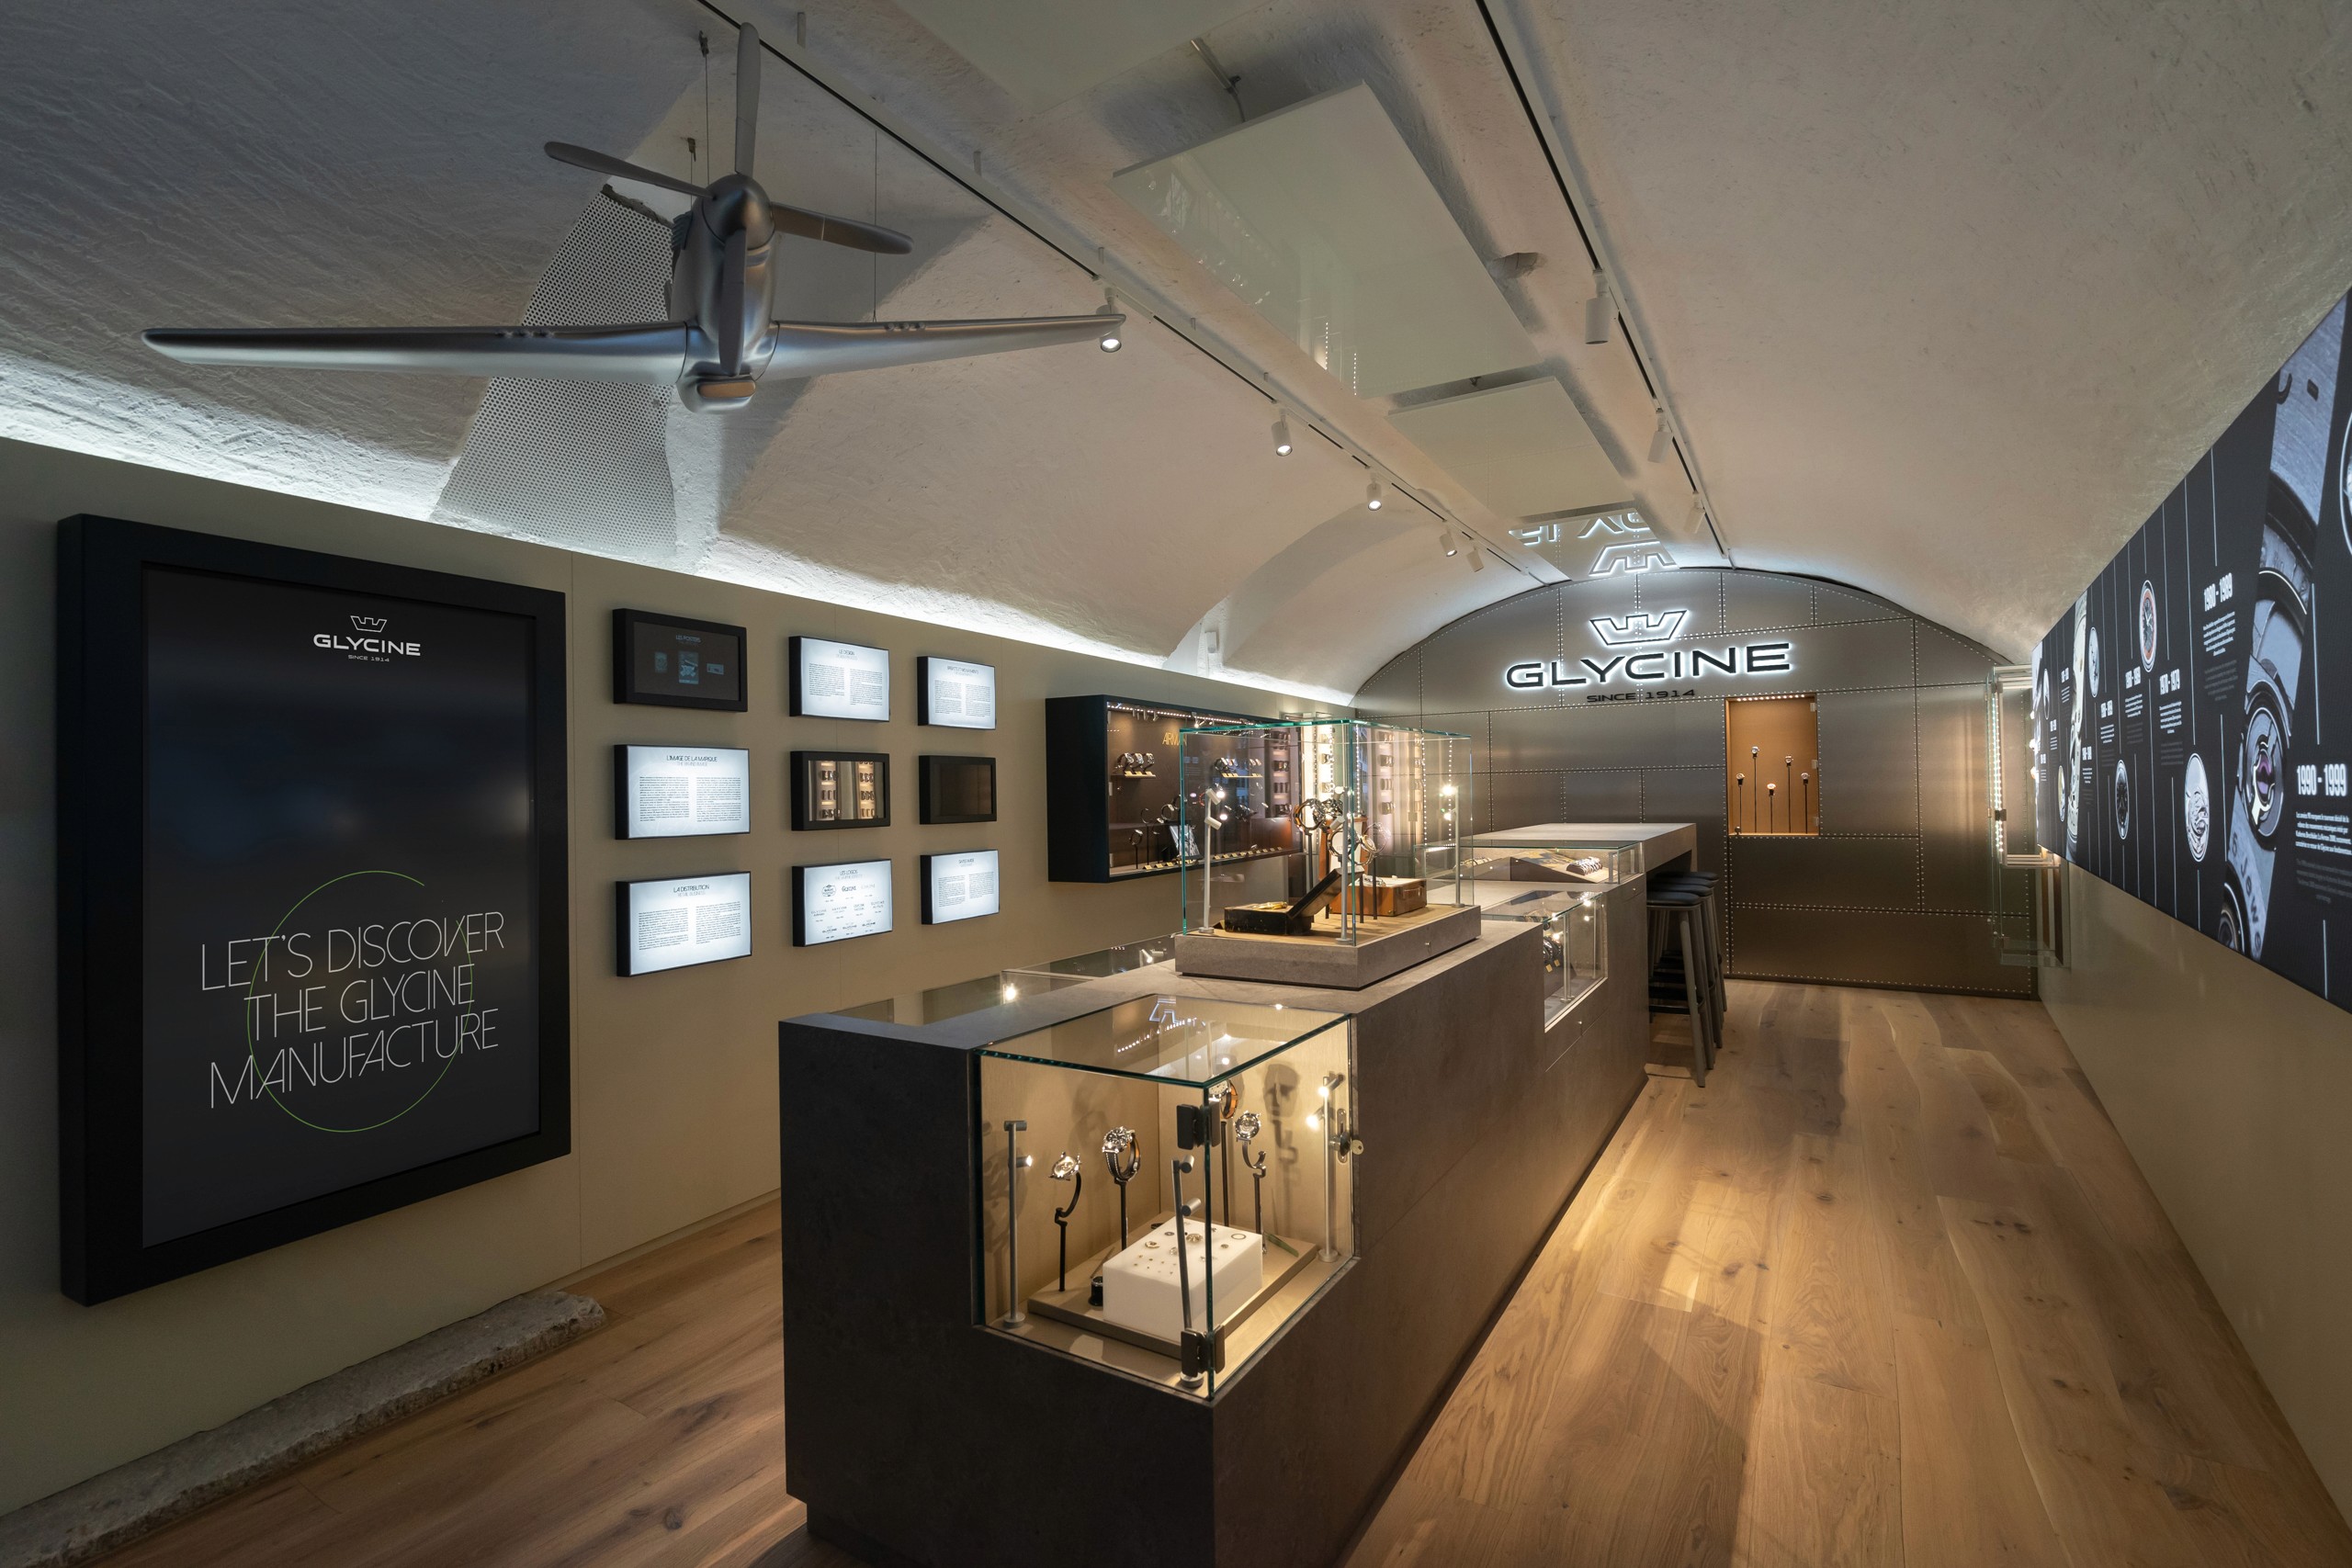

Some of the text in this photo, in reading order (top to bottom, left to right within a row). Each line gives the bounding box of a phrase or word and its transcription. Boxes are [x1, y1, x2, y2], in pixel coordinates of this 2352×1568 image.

[313, 634, 421, 657] GLYCINE
[1506, 642, 1792, 689] GLYCINE
[1587, 689, 1696, 703] SINCE 1914
[2297, 764, 2317, 795] 1990
[2324, 763, 2346, 796] 1999
[201, 911, 504, 991] LET'S DISCOVER
[243, 964, 475, 1042] THE GLYCINE
[210, 1009, 499, 1109] MANUFACTURE
